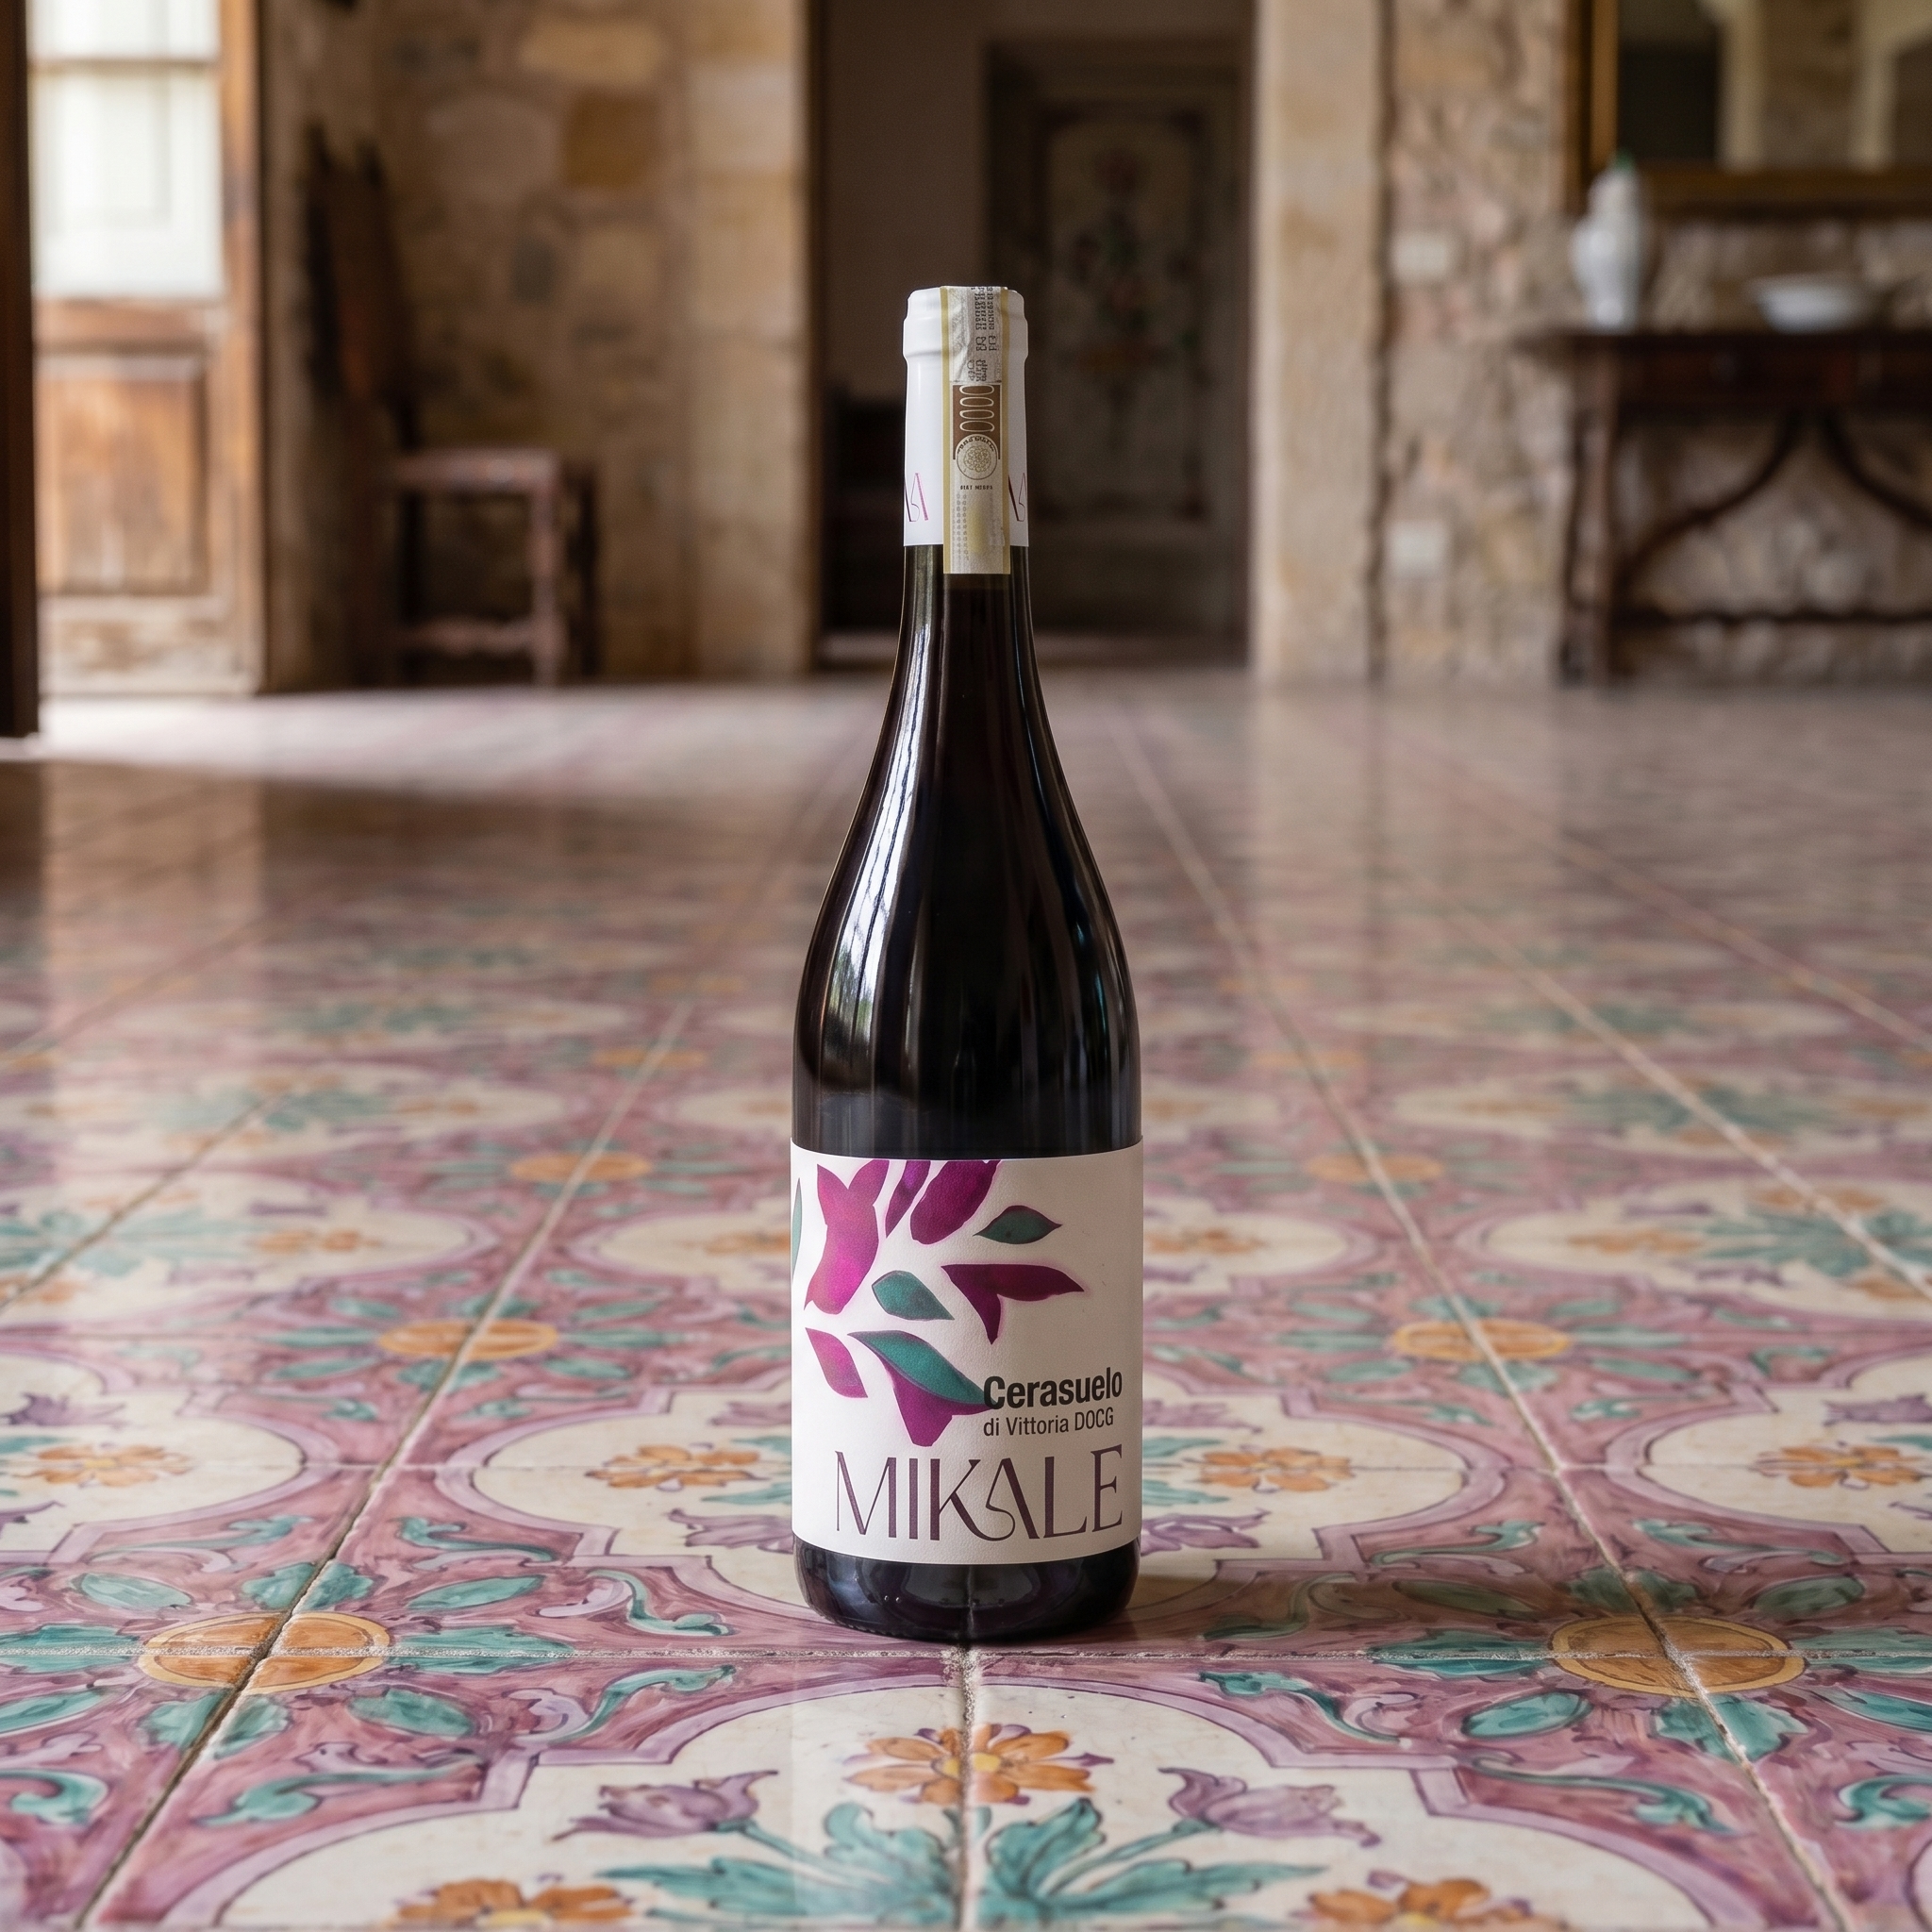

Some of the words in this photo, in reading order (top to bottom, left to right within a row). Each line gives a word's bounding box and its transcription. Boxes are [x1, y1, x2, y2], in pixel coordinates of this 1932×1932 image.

[983, 1367, 1123, 1409] Cerasuelo
[983, 1417, 1000, 1437] di
[1006, 1414, 1069, 1436] Vittoria
[1074, 1407, 1114, 1431] DOCG
[835, 1444, 1123, 1541] MIKALE
